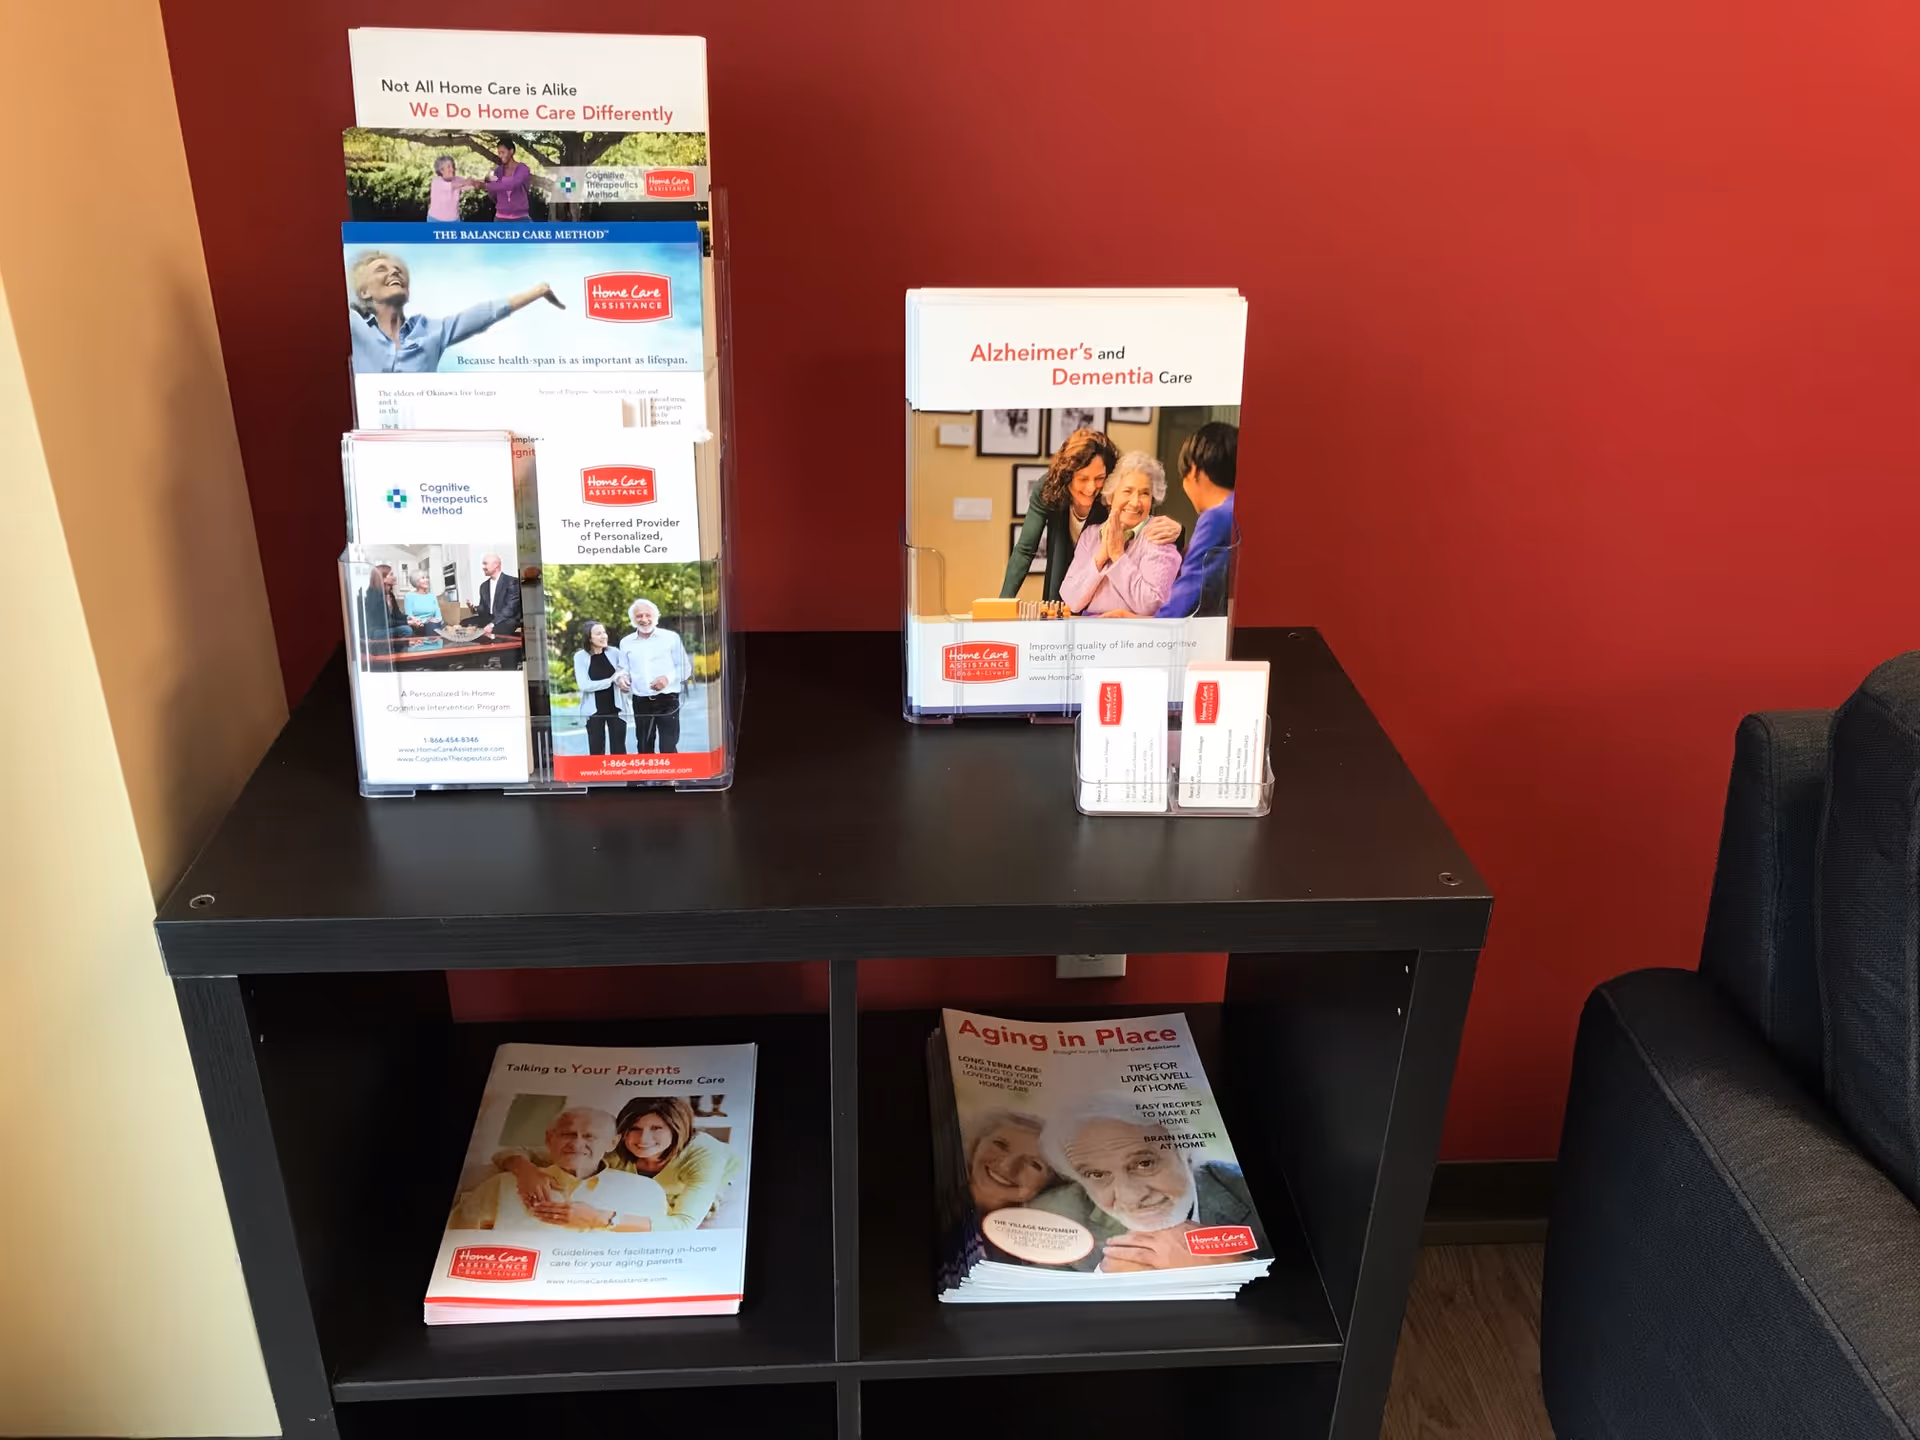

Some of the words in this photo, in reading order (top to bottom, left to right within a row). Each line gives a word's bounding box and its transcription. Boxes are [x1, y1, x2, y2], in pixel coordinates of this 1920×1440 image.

[381, 79, 409, 92] Not
[415, 80, 433, 93] All
[440, 81, 482, 94] Home
[488, 82, 520, 95] Care
[526, 83, 537, 95] is
[542, 83, 577, 96] Alike
[409, 102, 439, 117] We
[446, 103, 471, 118] Do
[478, 104, 529, 119] Home
[536, 104, 576, 120] Care
[583, 104, 673, 125] Differently
[586, 171, 624, 181] Cognitive
[586, 181, 638, 190] Therapeutics
[587, 190, 619, 198] Method
[433, 230, 457, 240] THE
[460, 230, 520, 240] BALANCED
[523, 230, 551, 240] CARE
[592, 284, 628, 298] Home
[631, 284, 661, 299] Care
[970, 342, 1093, 362] Alzheimer's
[1097, 346, 1125, 360] and
[457, 355, 495, 365] Because
[499, 355, 555, 367] health-span
[559, 356, 567, 365] is
[569, 357, 579, 365] as
[582, 355, 632, 367] important
[648, 355, 687, 367] lifespan.
[1052, 366, 1154, 386] Dementia
[1159, 371, 1193, 384] Care
[587, 475, 619, 487] Home
[621, 475, 647, 487] Care
[420, 483, 470, 493] Cognitive
[421, 495, 488, 504] Therapeutics
[422, 506, 463, 515] Method
[561, 519, 580, 528] The
[584, 518, 633, 528] Preferred
[637, 518, 680, 528] Provider
[580, 532, 591, 541] of
[594, 531, 663, 541] Personalized,
[577, 545, 640, 556] Dependable
[644, 545, 668, 553] Care
[1029, 642, 1075, 652] Improving
[1076, 641, 1107, 651] quality
[1109, 640, 1118, 649] of
[1121, 640, 1134, 649] life
[1137, 640, 1154, 649] and
[949, 648, 980, 660] Home
[983, 648, 1009, 660] Care
[1029, 653, 1057, 662] health
[1059, 653, 1068, 661] at
[1071, 653, 1096, 661] home
[410, 690, 459, 698] Personalized
[477, 704, 511, 713] Program
[602, 758, 670, 768] 1-866-454-8346
[959, 1019, 1048, 1051] Aging
[1057, 1030, 1085, 1047] in
[1096, 1027, 1177, 1046] Place
[958, 1055, 984, 1065] LONG
[987, 1060, 1012, 1070] TERM
[1128, 1063, 1152, 1072] TIPS
[1153, 1062, 1178, 1070] FOR
[507, 1063, 549, 1075] Talking
[554, 1065, 567, 1074] to
[571, 1064, 610, 1076] Your
[617, 1065, 680, 1076] Parents
[615, 1078, 653, 1086] About
[657, 1077, 693, 1086] Home
[697, 1076, 725, 1085] Care
[1121, 1073, 1159, 1083] LIVING
[1160, 1071, 1193, 1080] WELL
[1013, 1079, 1042, 1088] ABOUT
[1133, 1084, 1148, 1093] AT
[1150, 1082, 1188, 1092] HOME
[1162, 1100, 1202, 1109] RECIPES
[1144, 1134, 1175, 1142] BRAIN
[1177, 1132, 1216, 1140] HEALTH
[1174, 1141, 1207, 1149] HOME
[1008, 1221, 1036, 1230] VILLAGE
[1037, 1226, 1078, 1234] MOVEMENT
[1191, 1235, 1220, 1244] Home
[1222, 1233, 1246, 1242] Care
[460, 1249, 496, 1260] Home
[498, 1252, 528, 1262] Care
[552, 1247, 605, 1257] Guidelines
[608, 1247, 621, 1256] for
[624, 1246, 674, 1257] facilitating
[677, 1245, 717, 1254] in-home
[458, 1262, 528, 1270] ASSISTANCE
[574, 1259, 587, 1267] for
[590, 1260, 613, 1269] your
[616, 1258, 643, 1268] aging
[646, 1257, 683, 1267] parents
